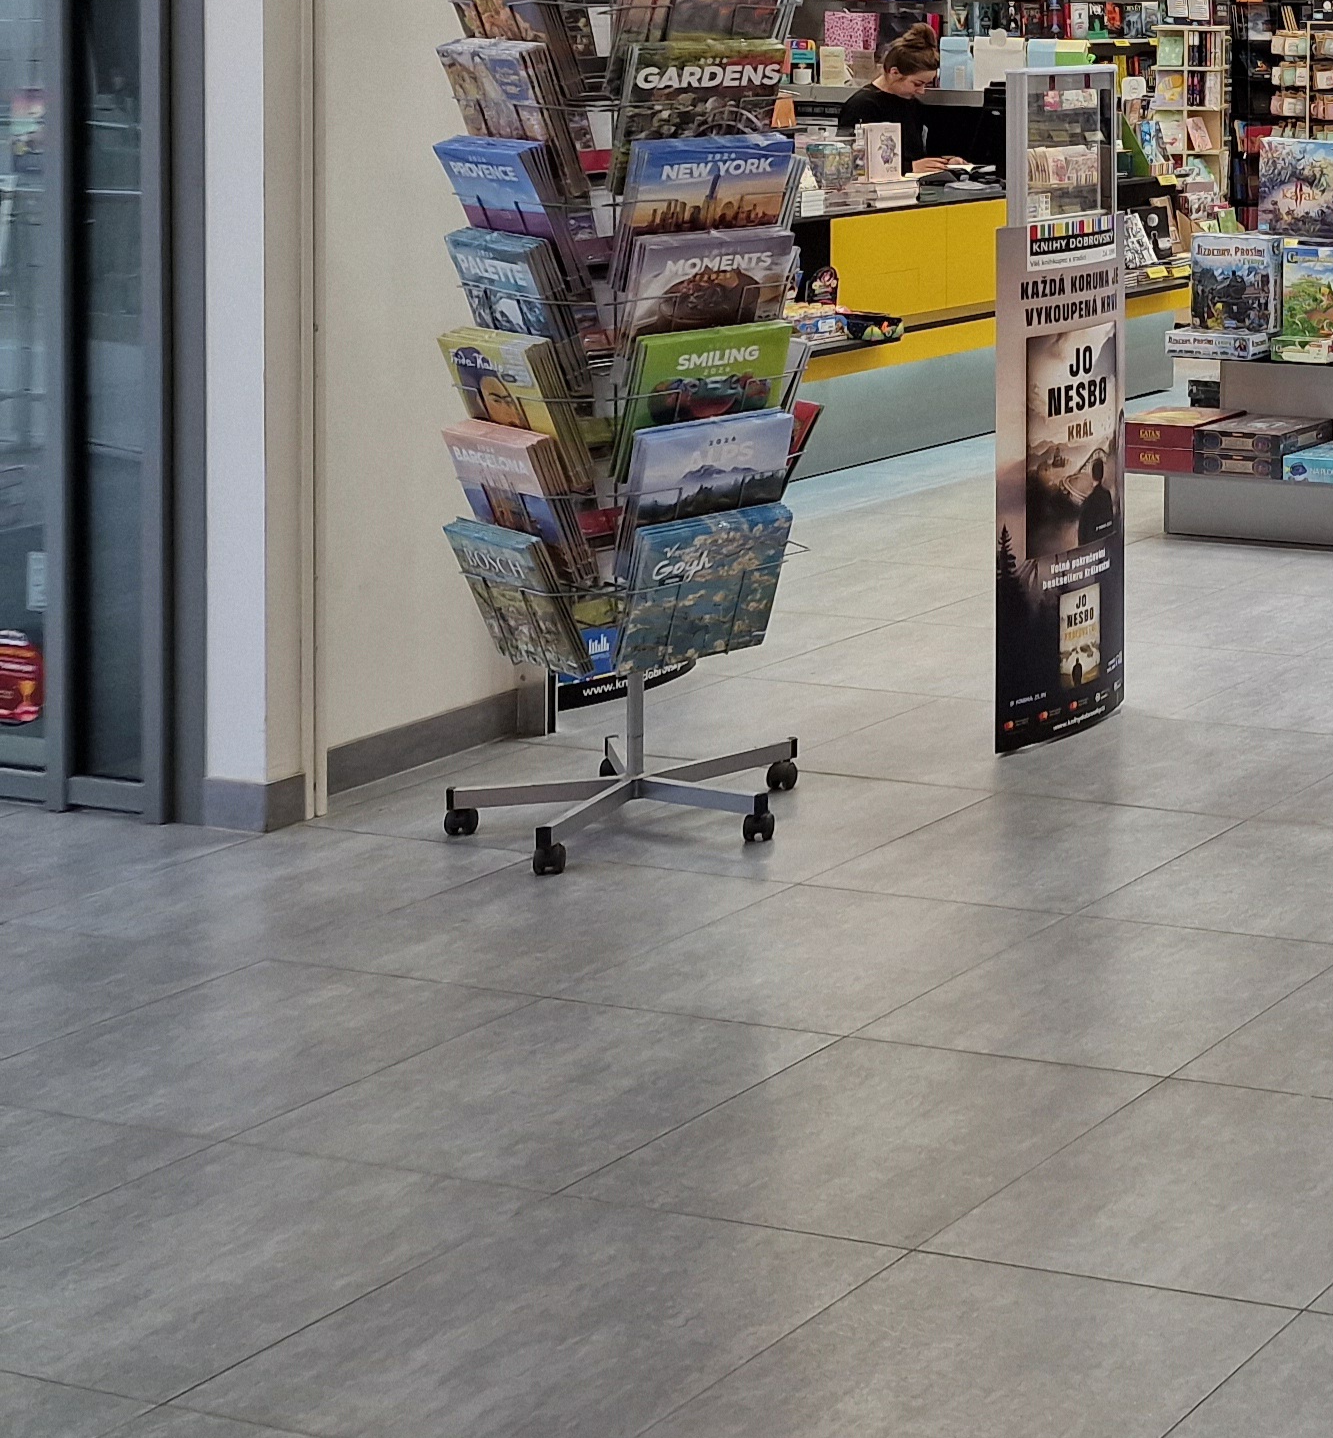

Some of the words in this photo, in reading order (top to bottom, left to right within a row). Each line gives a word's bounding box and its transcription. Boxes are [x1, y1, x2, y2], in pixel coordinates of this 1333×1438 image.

[636, 63, 781, 89] GARDENS
[450, 161, 519, 182] PROVENCE
[662, 161, 716, 181] NEW
[718, 157, 774, 176] YORK
[1032, 239, 1068, 253] KNIHY
[1069, 230, 1114, 249] DOBROVSKÝ
[456, 253, 527, 287] PALETTE
[664, 252, 773, 275] MOMENTS
[1020, 273, 1066, 301] KAŽDÁ
[1070, 269, 1110, 294] KORUNA
[1111, 266, 1119, 286] JE
[1025, 294, 1098, 327] VYKOUPENÁ
[676, 345, 760, 371] SMILING
[1068, 345, 1093, 378] JO
[1047, 375, 1107, 418] NESBØ
[708, 436, 737, 446] 2026
[1067, 418, 1094, 443] KRÁL
[452, 445, 530, 474] BARCELONA
[464, 546, 527, 579] BOSCH
[652, 555, 713, 584] Gogh
[1075, 593, 1087, 610] JO
